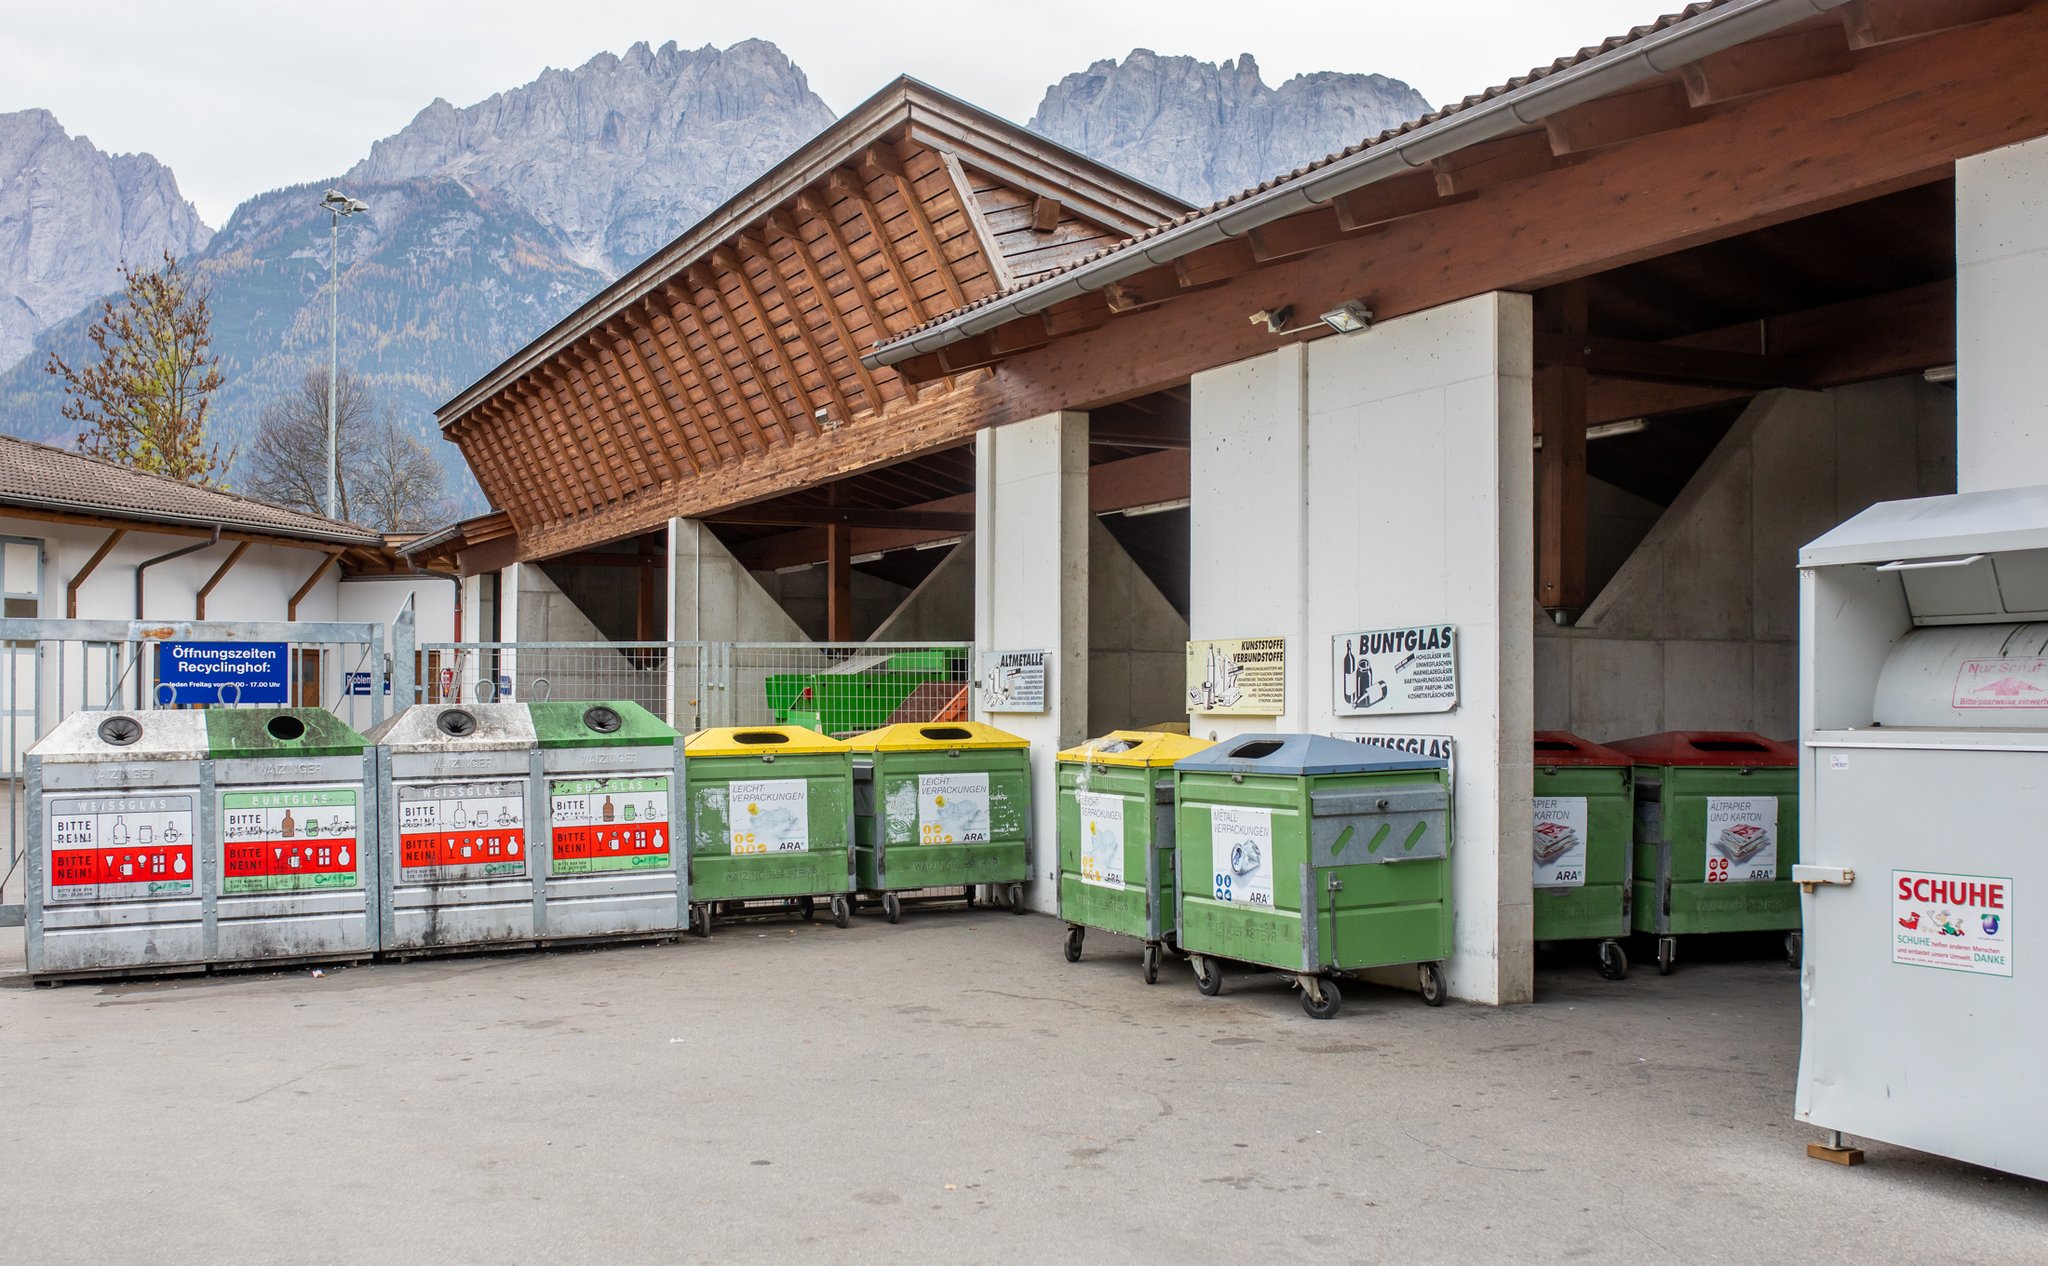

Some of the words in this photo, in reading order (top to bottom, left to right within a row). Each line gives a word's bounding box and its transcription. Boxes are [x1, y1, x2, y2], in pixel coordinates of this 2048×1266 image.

[1241, 639, 1283, 651] KUNSTSTOFFE
[1359, 626, 1452, 655] BUNTGLAS
[172, 645, 276, 660] Öffnungszeiten
[1233, 651, 1283, 663] VERBUNDSTOFFE
[1000, 652, 1044, 668] ALTMETALLE
[178, 661, 271, 675] Recyclinghof:
[188, 681, 212, 689] Freitag
[1960, 697, 1977, 705] Bitte
[921, 777, 951, 787] LEICHT-
[422, 786, 501, 798] WEISSGLAS
[921, 785, 987, 795] VERPACKUNGEN
[252, 794, 329, 806] BUNTGLAS
[732, 792, 805, 803] VERPACKUNGEN
[77, 799, 167, 812] WEISSGLAS
[557, 800, 585, 810] BITTE
[1710, 801, 1751, 811] ALTPAPIER
[405, 806, 435, 817] BITTE
[1533, 810, 1570, 820] KARTON
[1710, 812, 1728, 822] UND
[1730, 812, 1762, 821] KARTON
[229, 814, 262, 825] BITTE
[57, 820, 92, 832] BITTE
[1213, 823, 1270, 837] VERPACKUNGEN
[57, 833, 92, 844] REIN!
[557, 831, 585, 842] BITTE
[963, 832, 984, 841] ARA
[405, 839, 435, 850] BITTE
[557, 843, 586, 853] NEIN!
[779, 841, 802, 850] ARA
[229, 848, 262, 859] BITTE
[405, 850, 436, 861] NEIN!
[57, 855, 92, 867] BITTE
[229, 860, 262, 871] NEIN!
[57, 868, 92, 879] NEIN!
[1556, 871, 1578, 881] ARA
[1749, 869, 1770, 880] ARA
[1249, 891, 1267, 905] ARA
[1898, 877, 2004, 909] SCHUHE
[1897, 934, 1930, 947] SCHUHE
[1931, 941, 1948, 949] helfen
[1949, 942, 1971, 951] anderen
[1972, 945, 2000, 954] Menschen
[1908, 948, 1931, 956] entlastet
[1931, 951, 1948, 959] unsere
[1950, 952, 1971, 961] Umwelt.
[1973, 952, 2005, 965] DANKE
